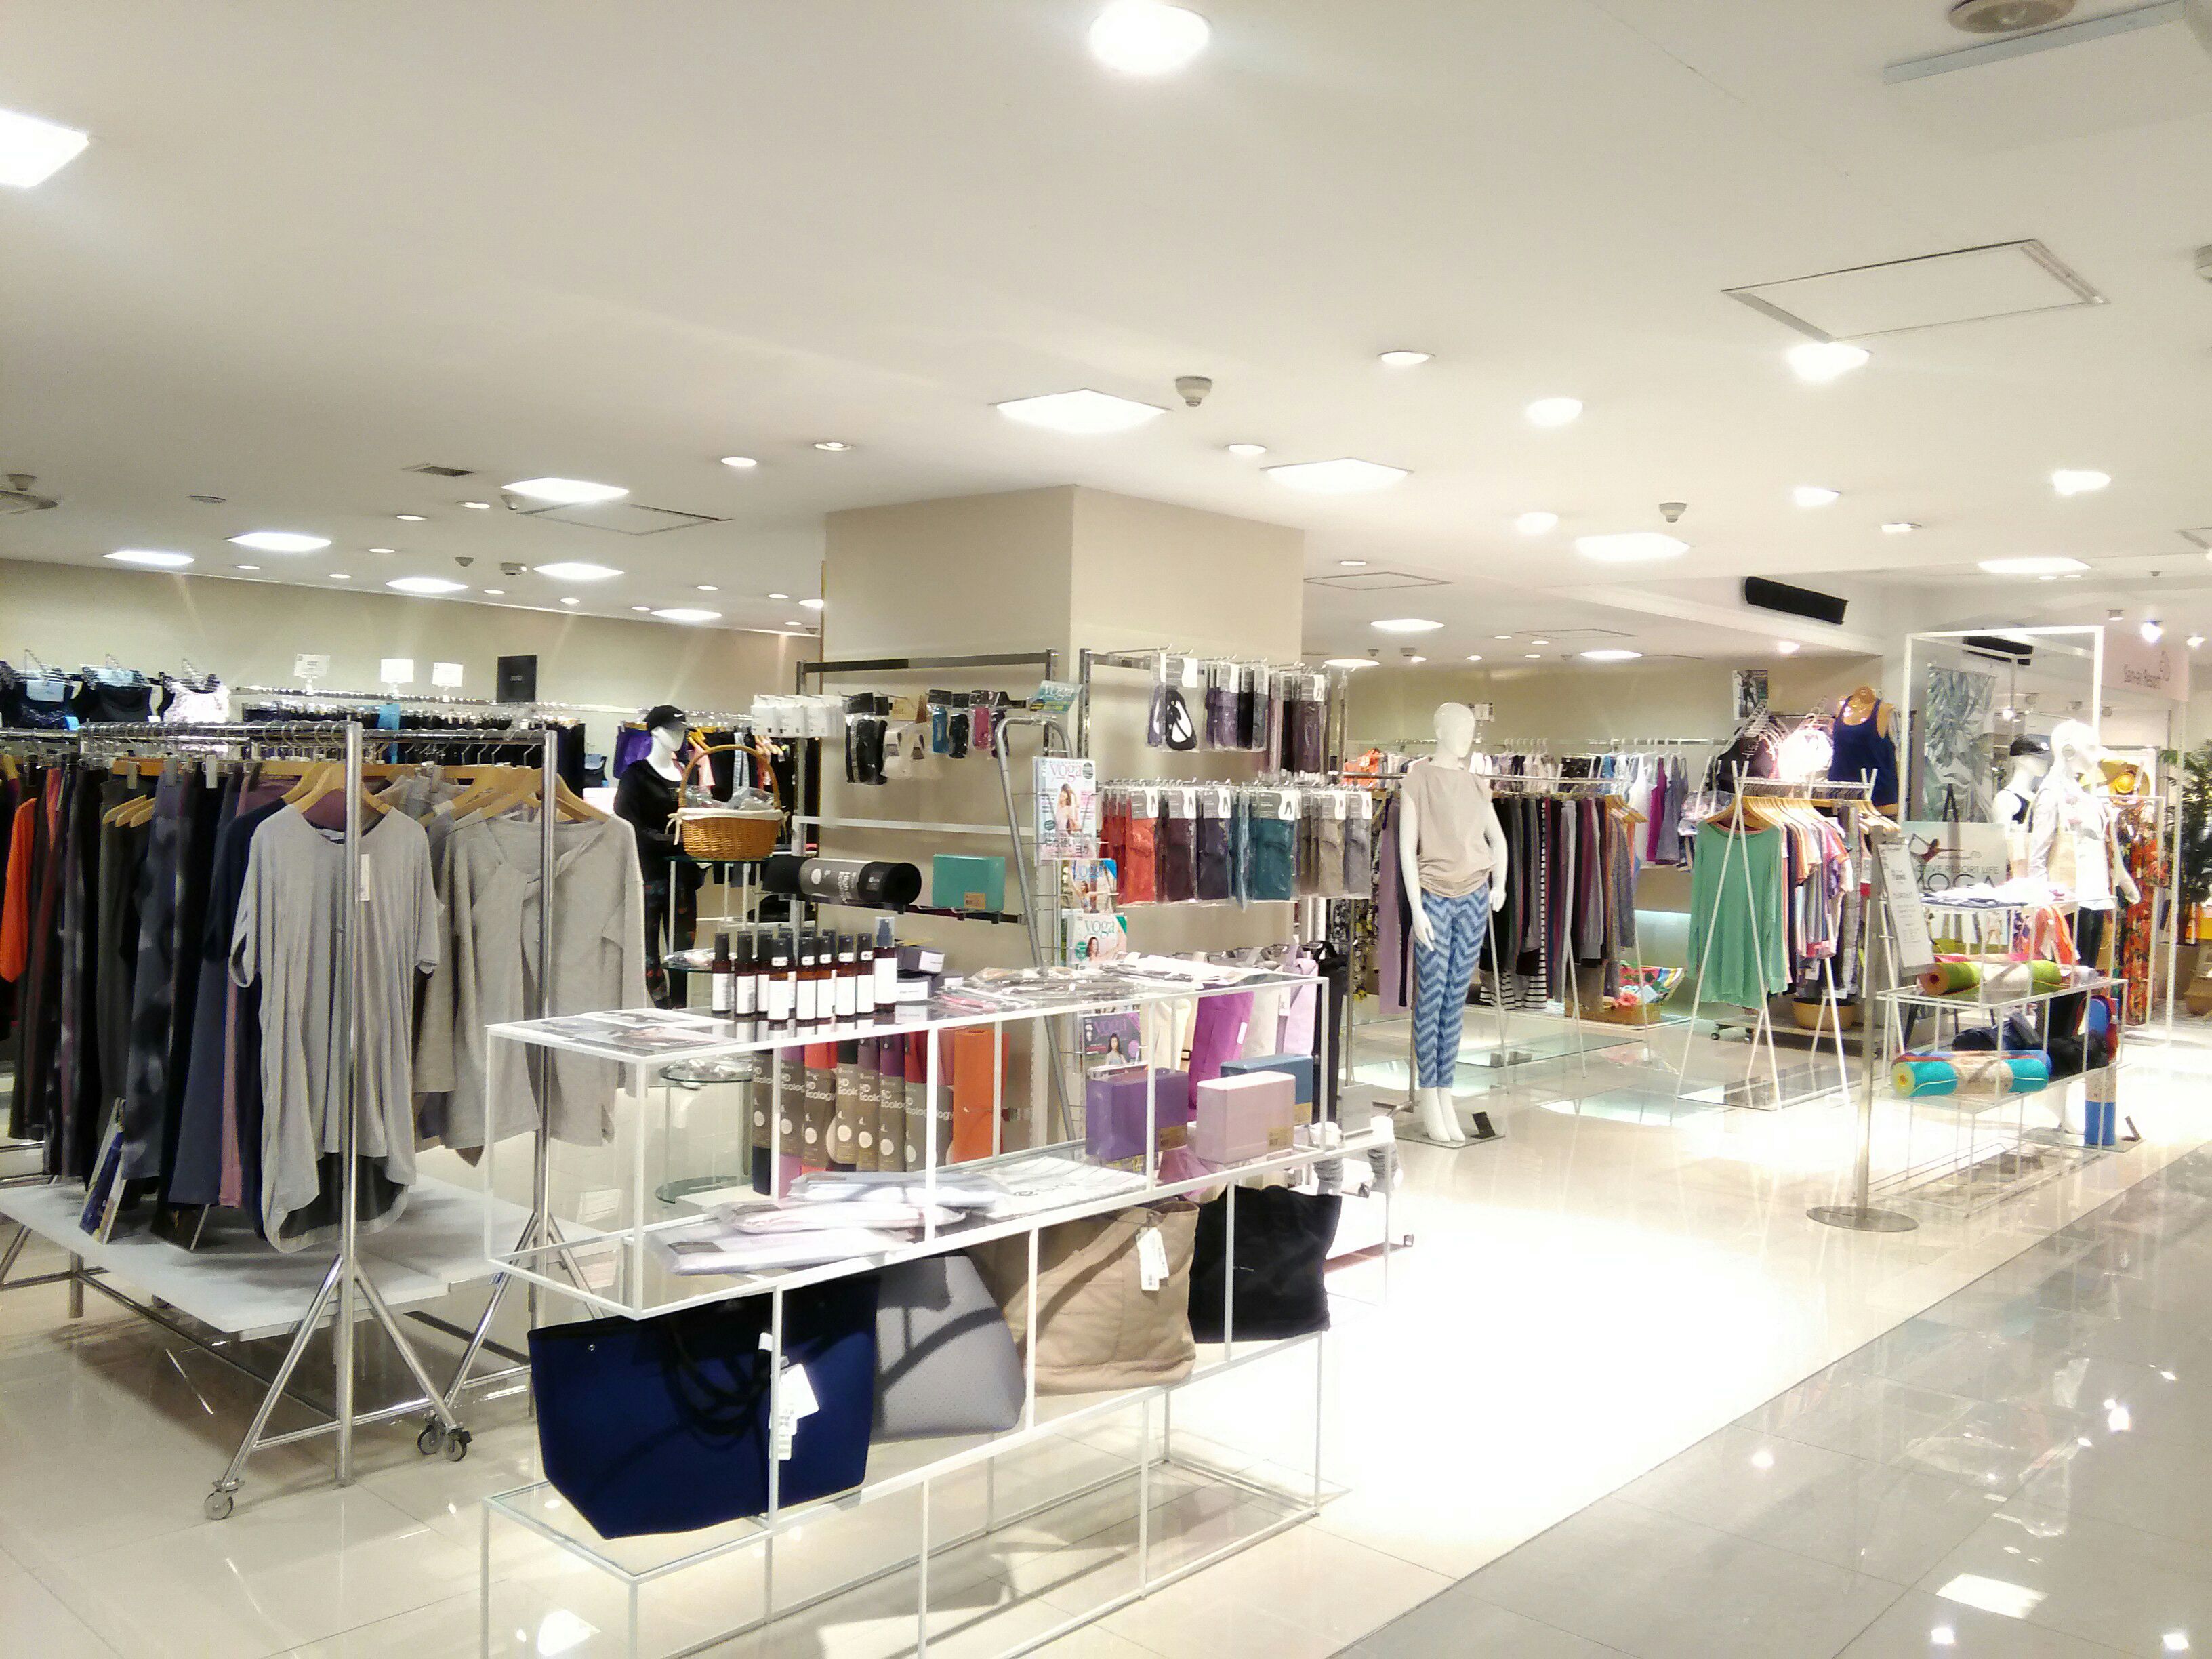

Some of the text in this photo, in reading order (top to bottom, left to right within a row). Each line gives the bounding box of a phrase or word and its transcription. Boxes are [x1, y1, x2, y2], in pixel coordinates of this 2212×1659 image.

[1048, 763, 1082, 783] yoga
[1084, 919, 1115, 939] yoga
[838, 1078, 850, 1087] HD
[859, 1083, 872, 1093] HD
